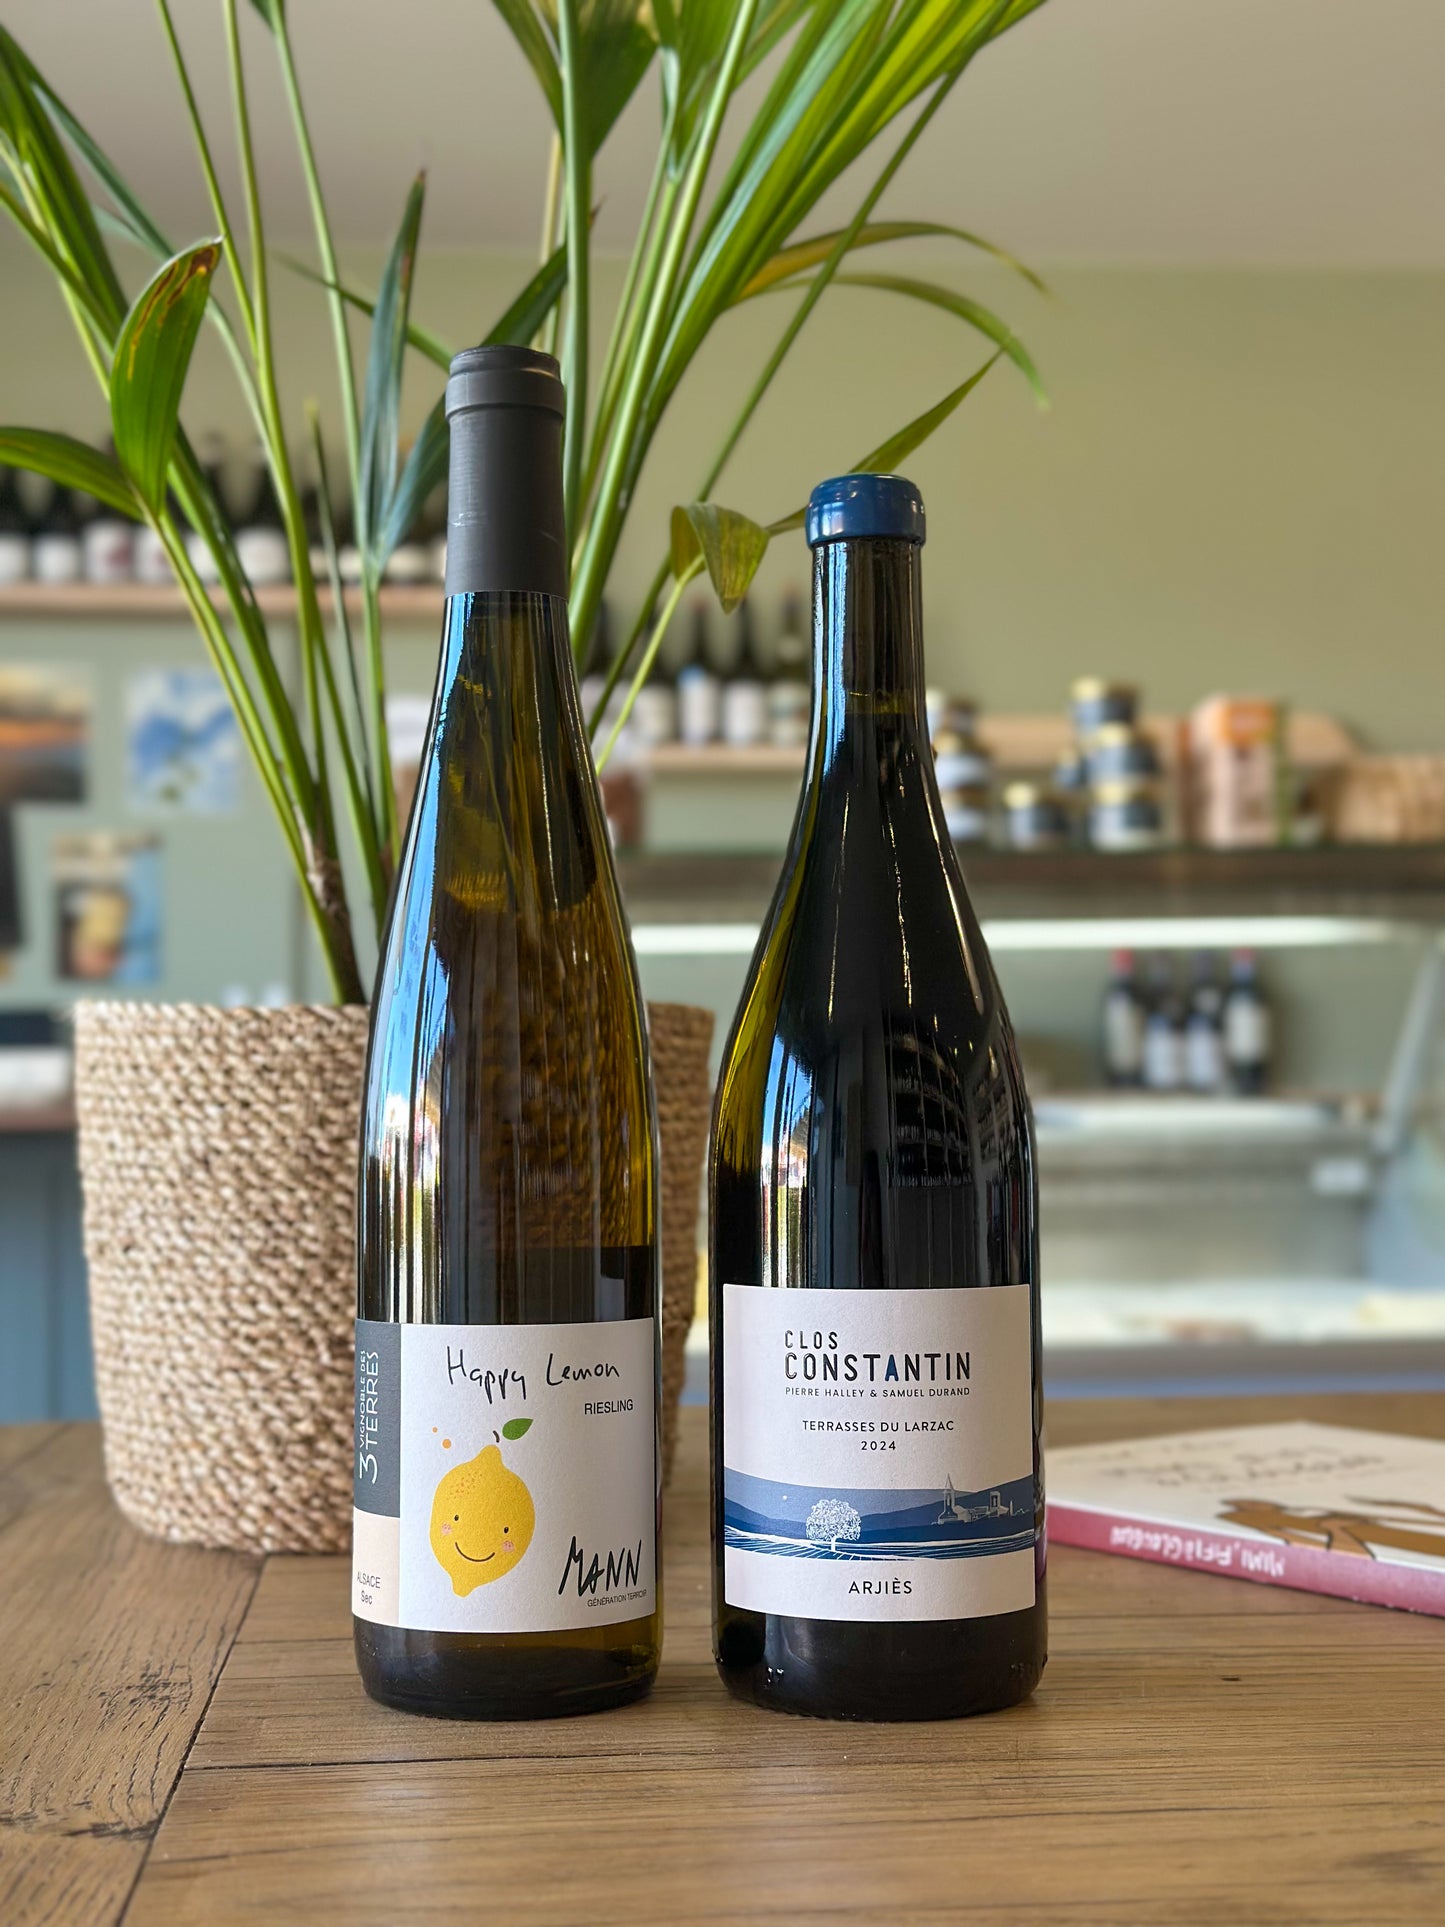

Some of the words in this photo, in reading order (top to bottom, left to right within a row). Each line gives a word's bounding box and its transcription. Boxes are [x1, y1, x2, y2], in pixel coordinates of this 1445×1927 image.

[785, 1330, 838, 1350] CLOS
[447, 1346, 526, 1404] Happy
[546, 1353, 620, 1386] Lemon
[785, 1352, 971, 1382] CONSTANTIN
[366, 1351, 379, 1450] TERRES
[785, 1386, 820, 1397] PIERRE
[825, 1388, 865, 1398] HALLEY
[869, 1389, 878, 1398] &
[882, 1388, 925, 1398] SAMUEL
[929, 1387, 970, 1397] DURAND
[584, 1399, 634, 1415] RIESLING
[802, 1420, 875, 1432] TERRASSES
[880, 1421, 899, 1432] DU
[904, 1420, 954, 1432] LARZAC
[861, 1440, 896, 1451] 2024
[359, 1451, 378, 1484] 3
[558, 1535, 642, 1597] MANN
[357, 1571, 381, 1589] ALSACE
[848, 1577, 912, 1594] ARJIÈS
[360, 1590, 373, 1605] Sec
